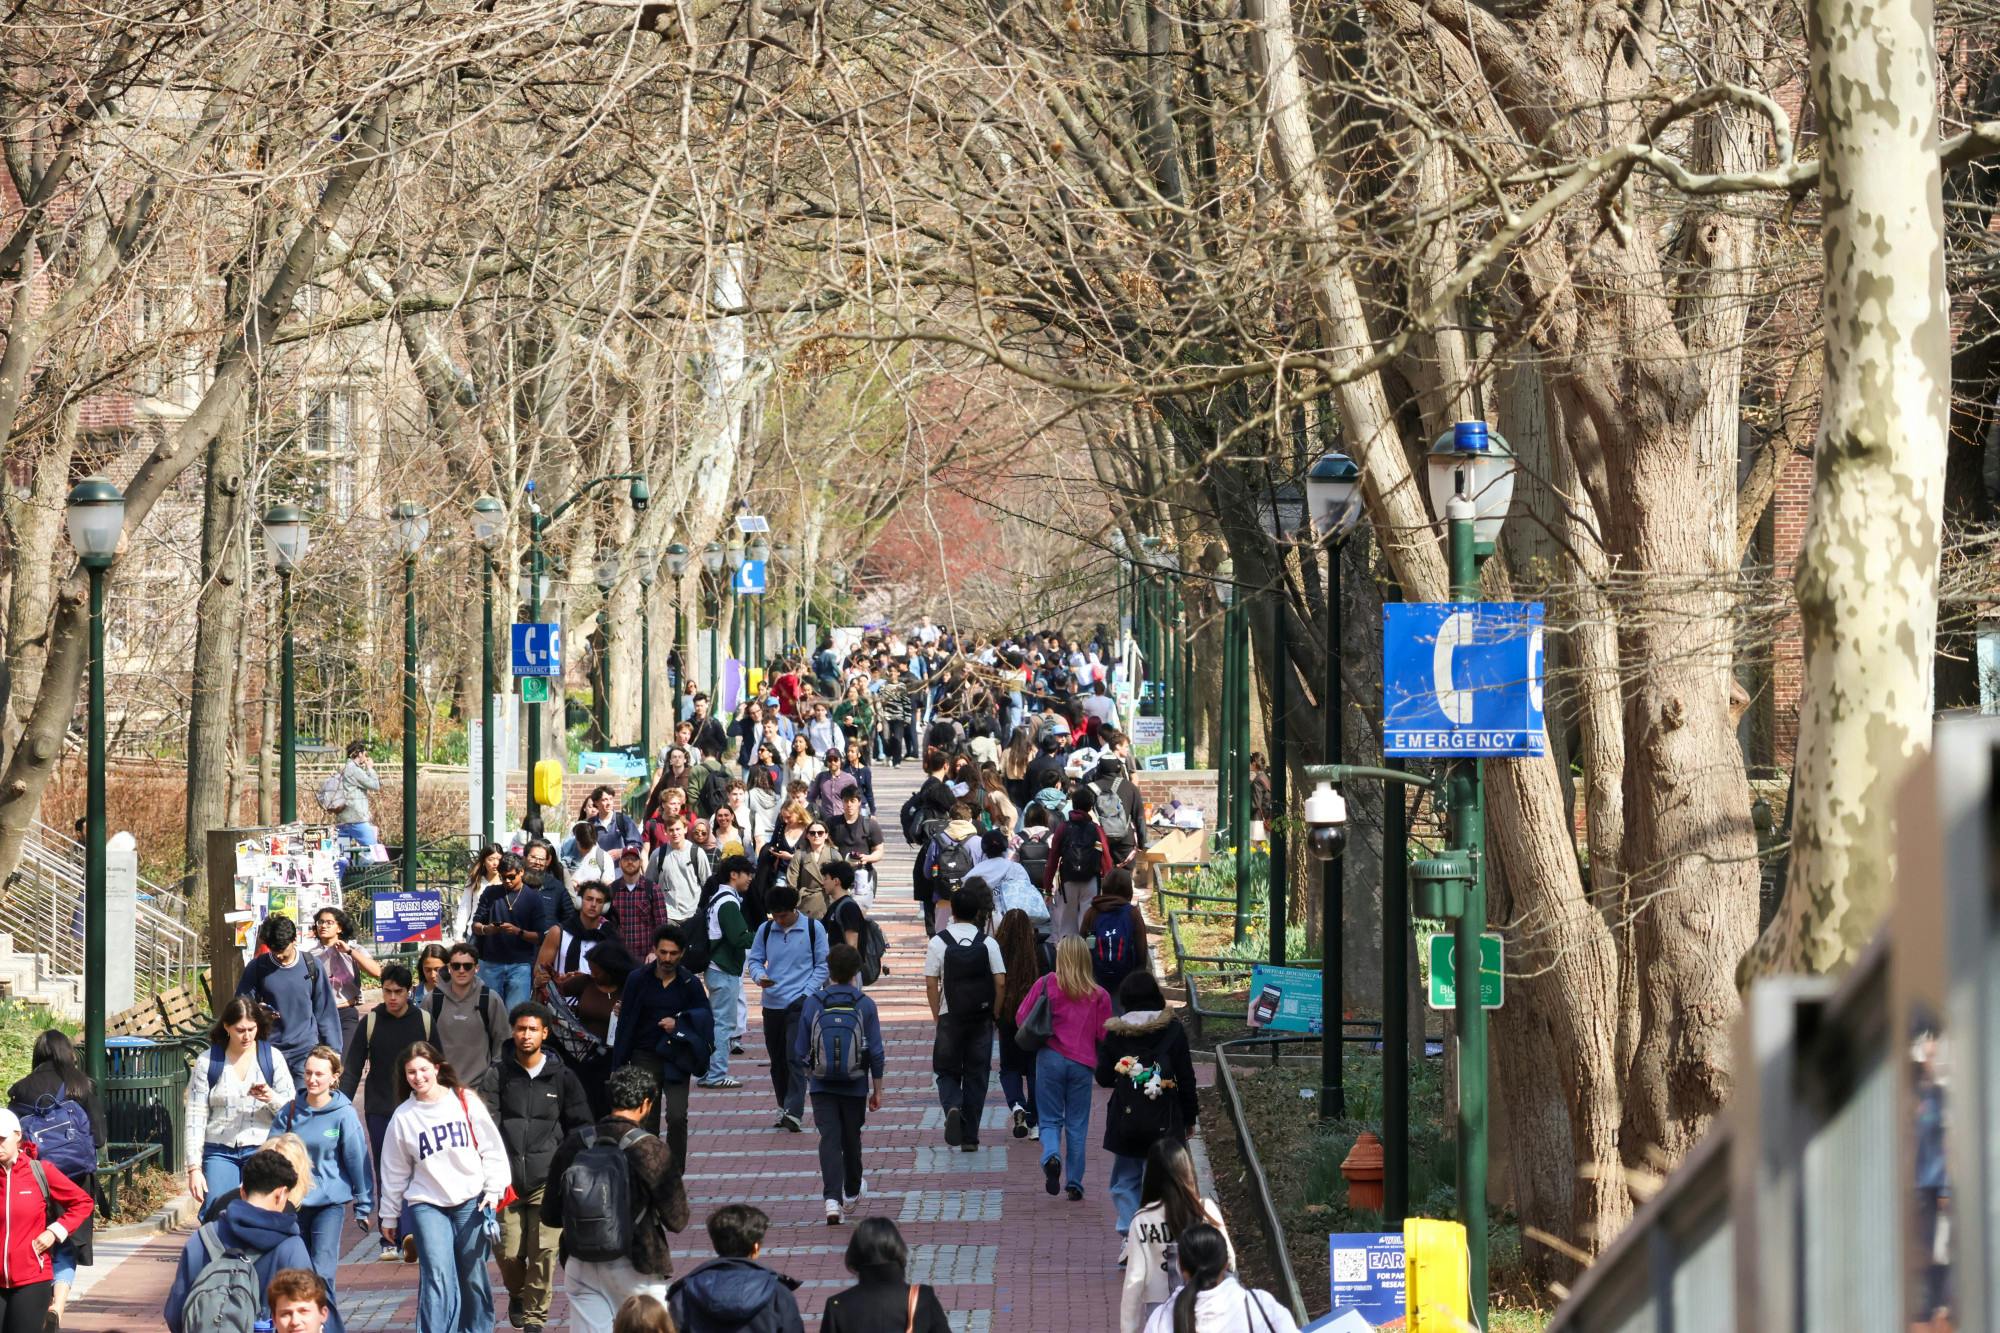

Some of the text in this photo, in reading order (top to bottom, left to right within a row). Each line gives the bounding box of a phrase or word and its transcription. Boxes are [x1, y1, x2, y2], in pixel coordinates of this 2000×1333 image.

[1395, 733, 1516, 748] EMERGENCY
[394, 900, 440, 911] EARN $$$
[1369, 1252, 1404, 1269] EAR
